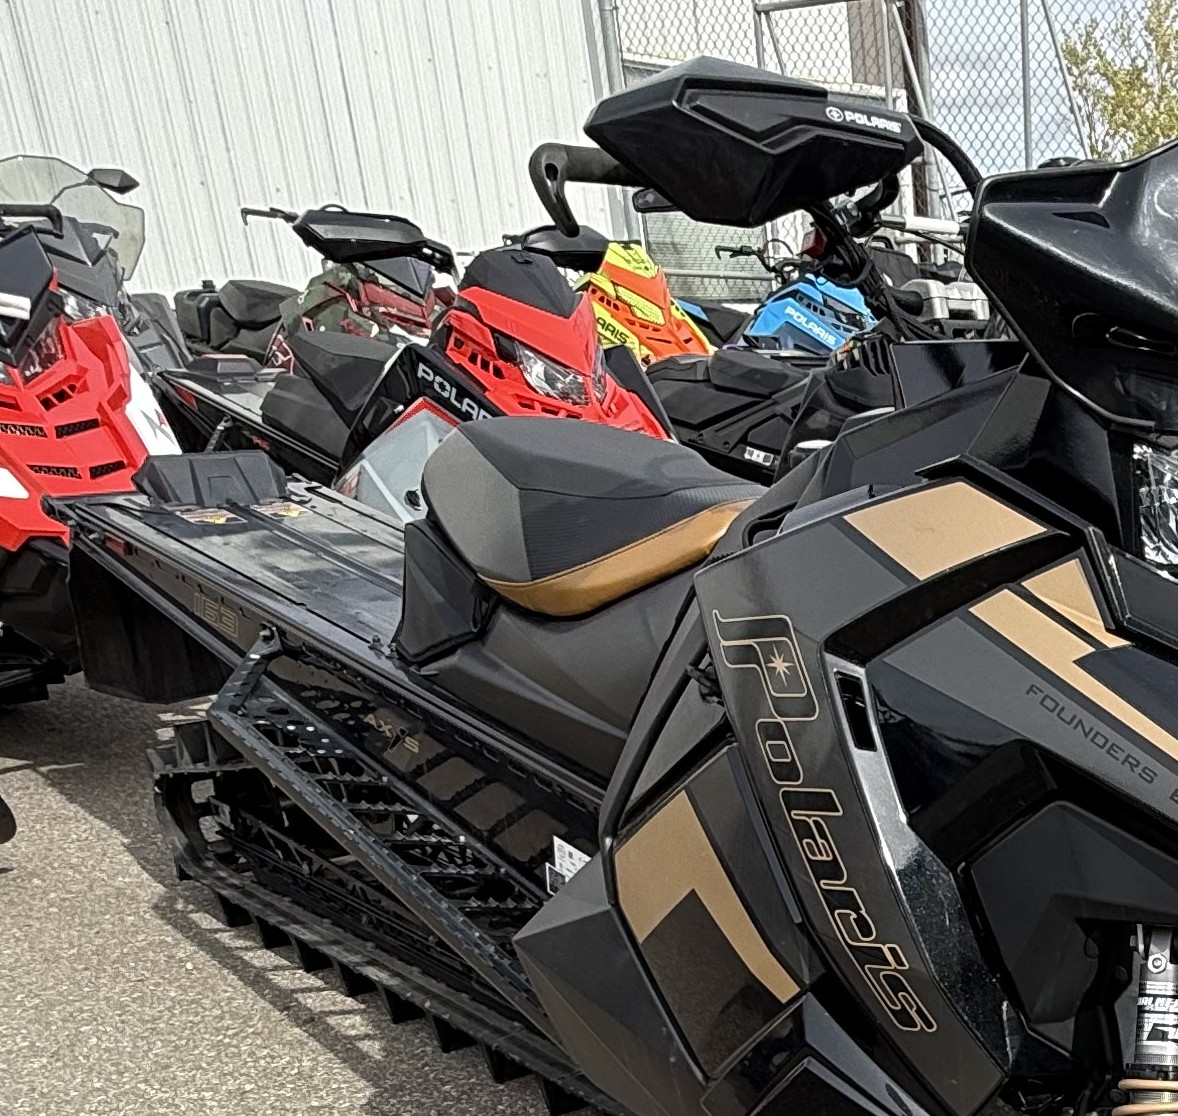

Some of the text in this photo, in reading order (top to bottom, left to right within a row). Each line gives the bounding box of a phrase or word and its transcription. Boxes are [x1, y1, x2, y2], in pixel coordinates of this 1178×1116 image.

[844, 110, 902, 133] POLARIS
[596, 316, 630, 345] ARIS
[784, 305, 837, 346] POLARIS
[1025, 683, 1158, 785] FOUNDERS
[712, 609, 938, 1033] Polaris
